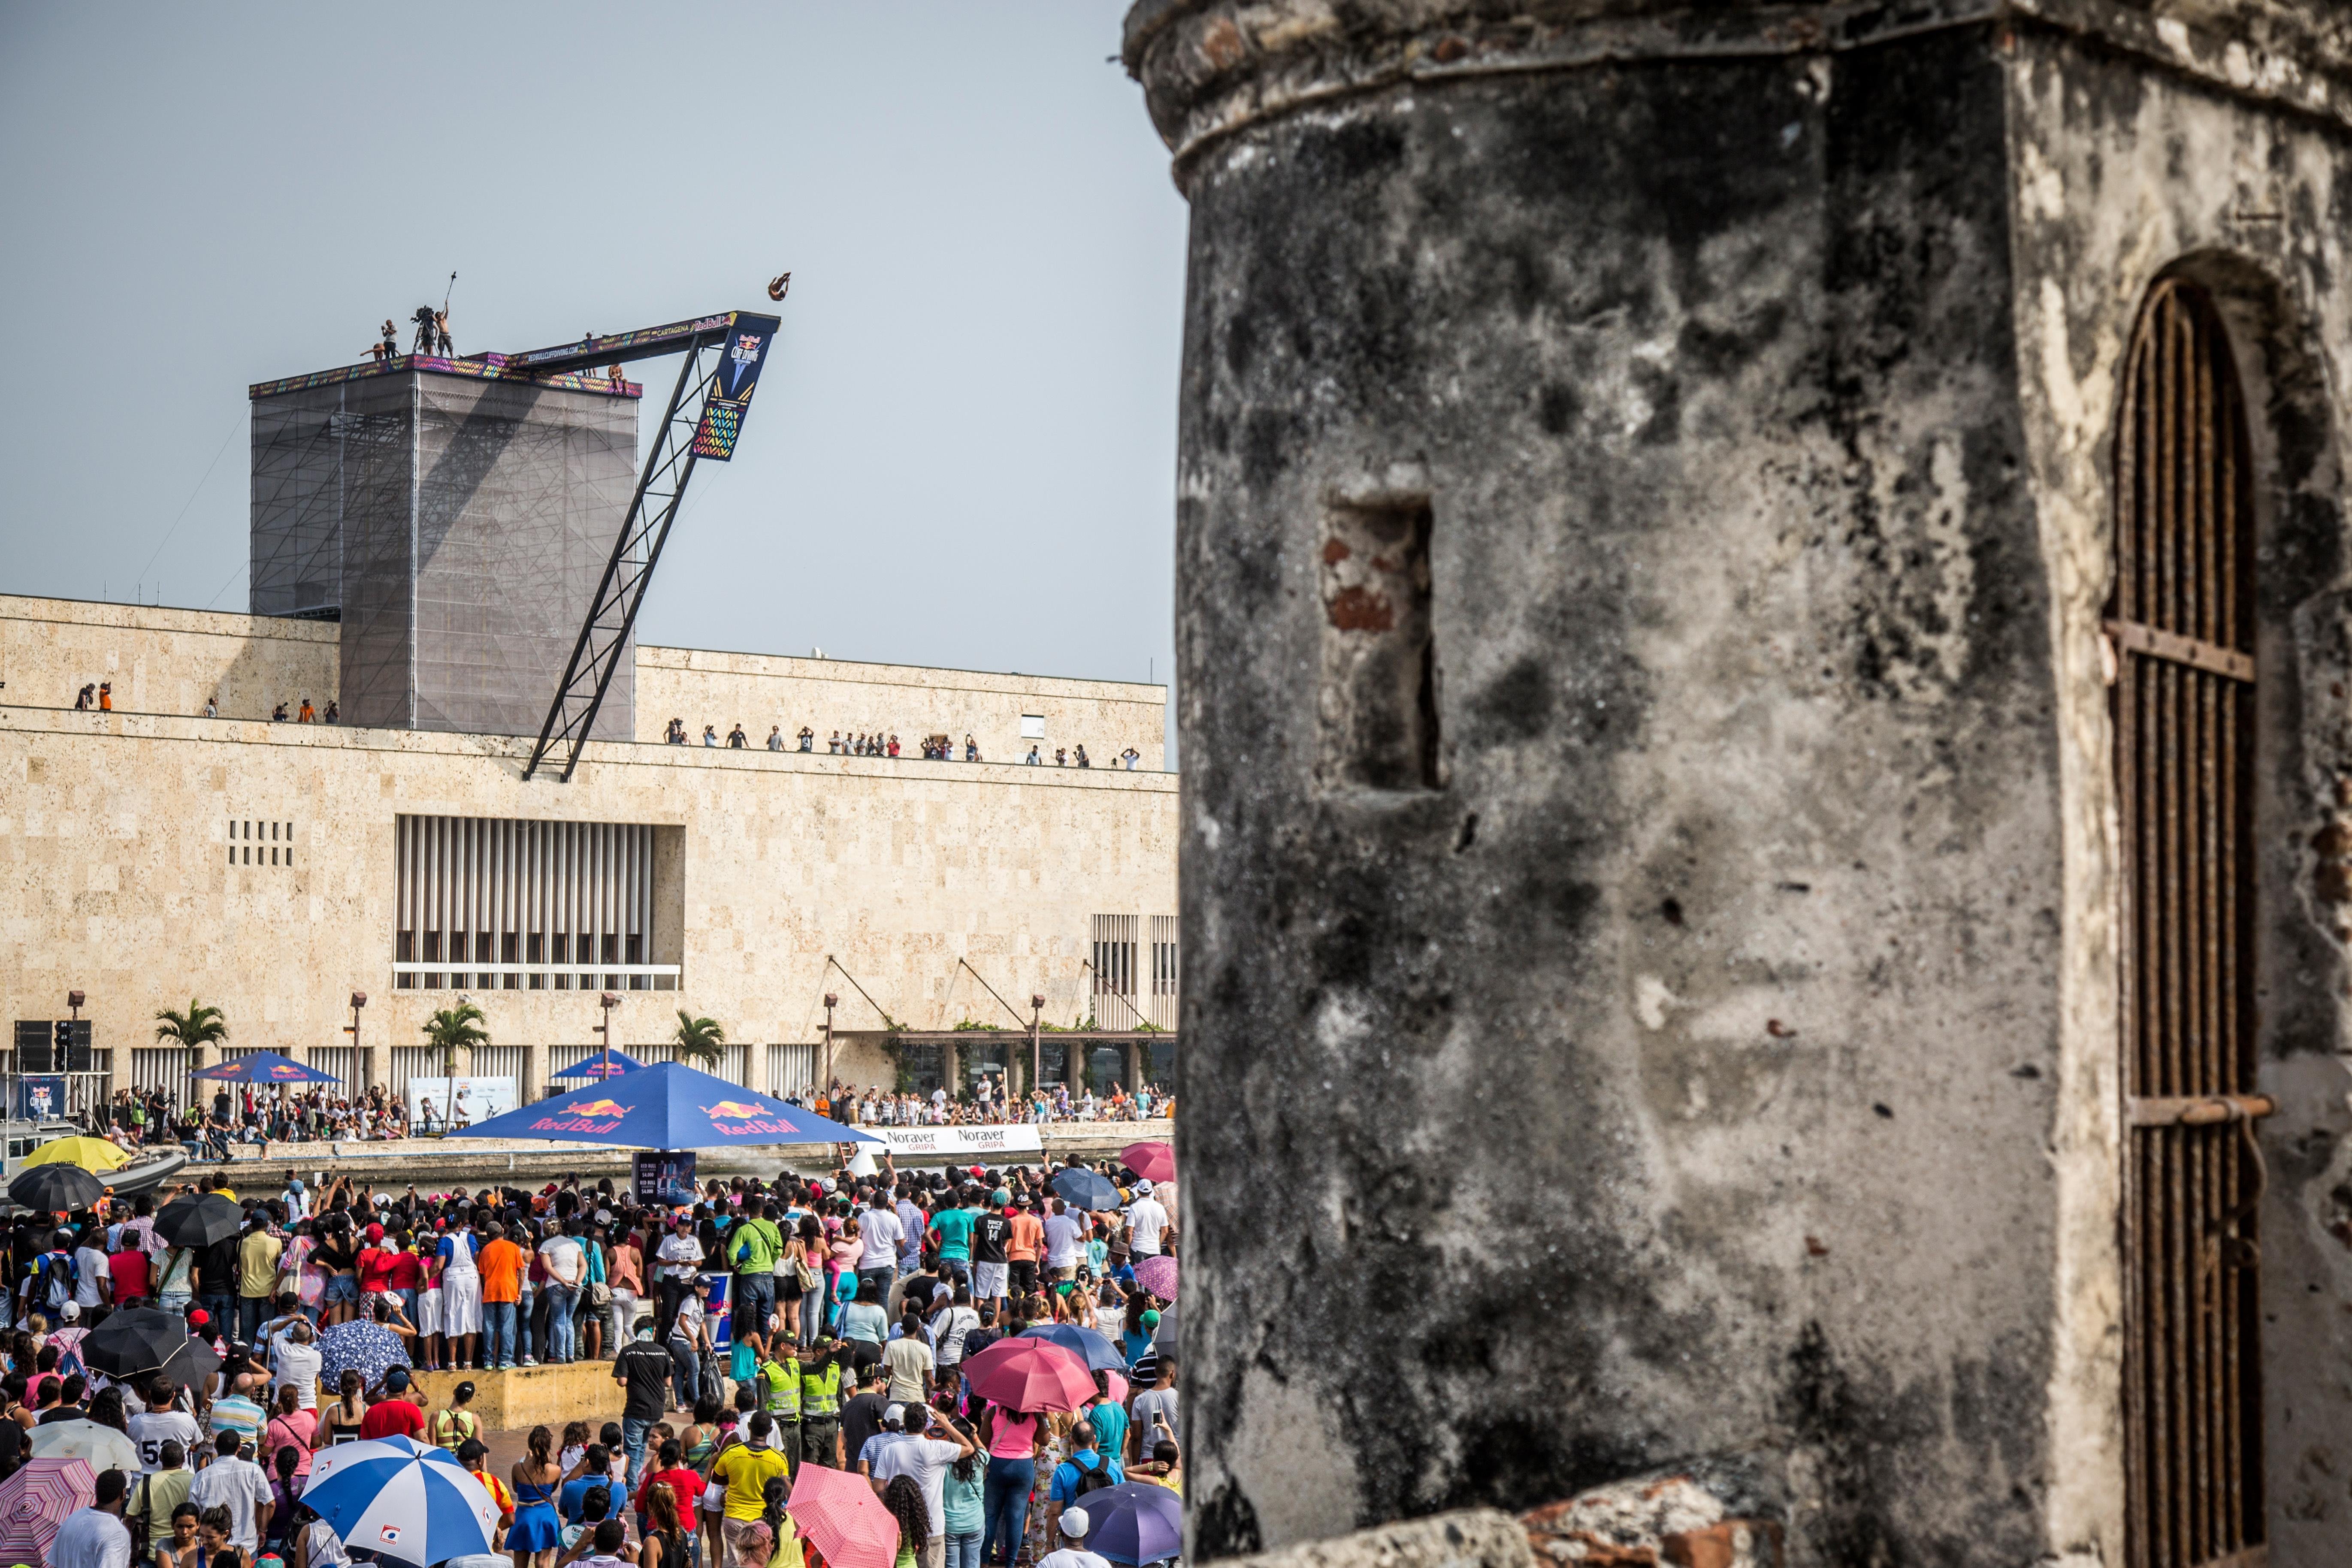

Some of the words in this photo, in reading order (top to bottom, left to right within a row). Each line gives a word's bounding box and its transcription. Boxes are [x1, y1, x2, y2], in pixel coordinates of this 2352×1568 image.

[695, 318, 707, 331] Red
[707, 316, 720, 329] Bull
[657, 325, 689, 337] CARTAGENA
[528, 345, 578, 362] REDBULLCLIFFDIVING.COM
[731, 346, 743, 358] CLIFF
[741, 350, 759, 362] DIVING
[30, 1097, 39, 1107] CLIFF
[529, 1117, 579, 1130] Red
[568, 1118, 622, 1134] Bull
[712, 1120, 764, 1135] Red
[753, 1118, 801, 1133] Bull
[887, 1131, 935, 1144] Noraver
[958, 1129, 1004, 1141] Noraver
[909, 1143, 936, 1151] GRIPA
[979, 1141, 1005, 1149] GRIPA
[988, 1230, 998, 1241] 14
